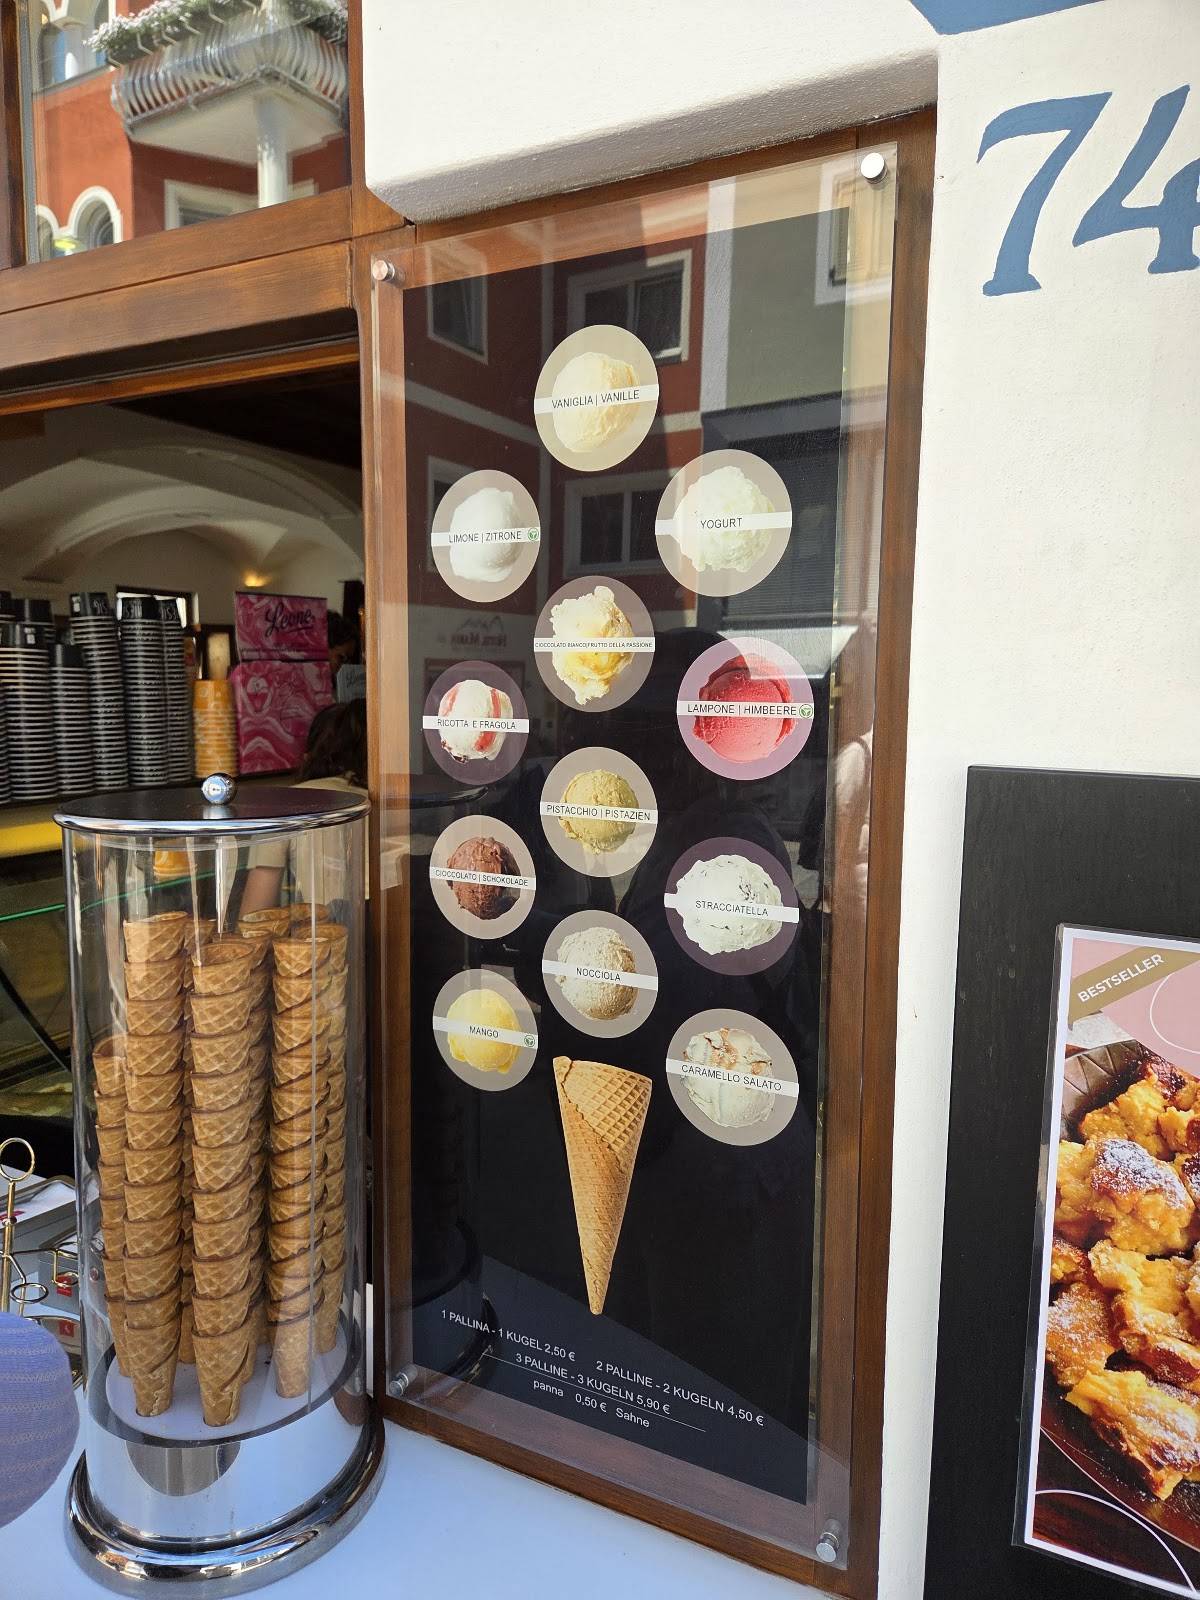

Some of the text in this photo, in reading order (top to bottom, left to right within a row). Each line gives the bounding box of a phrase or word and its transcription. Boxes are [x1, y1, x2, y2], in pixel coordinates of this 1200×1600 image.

[976, 84, 1200, 297] 74
[551, 395, 594, 409] VANIGLIA
[600, 389, 640, 403] VANILLE
[700, 517, 743, 529] YOGURT
[448, 532, 479, 544] LIMONE
[485, 530, 522, 542] ZITRONE
[265, 602, 315, 637] Leone
[687, 703, 735, 714] LAMPONE
[743, 705, 797, 716] HIMBEERE
[437, 718, 516, 730] RICOTTA E FRAGOLA
[546, 804, 598, 817] PISTACCHIO
[605, 809, 651, 821] PISTAZIEN
[435, 869, 477, 880] CIOCCOLATO
[482, 874, 529, 887] SCHOKOLADE
[695, 900, 769, 917] STRACCIATELLA
[576, 967, 621, 982] NOCCIOLA
[1077, 953, 1165, 1003] BESTSELLER
[469, 1025, 499, 1039] MANGO
[681, 1064, 782, 1092] CARAMELLO SALATO
[441, 1309, 447, 1319] 1
[449, 1311, 490, 1333] PALLINA
[498, 1327, 503, 1338] 1
[506, 1330, 542, 1351] KUGEL
[544, 1343, 566, 1358] 2,50
[568, 1351, 576, 1362] €
[596, 1359, 603, 1371] 2
[606, 1363, 653, 1388] PALLINE
[663, 1383, 670, 1394] 2
[673, 1386, 724, 1413] KUGELN
[727, 1405, 753, 1422] 4,50
[755, 1415, 764, 1427] €
[515, 1353, 522, 1363] 3
[524, 1355, 568, 1379] PALLINE
[577, 1374, 584, 1384] 3
[586, 1377, 634, 1402] KUGELN
[636, 1394, 660, 1411] 5,90
[663, 1403, 671, 1415] €
[533, 1380, 650, 1428] panna 0,50 € Sahne
